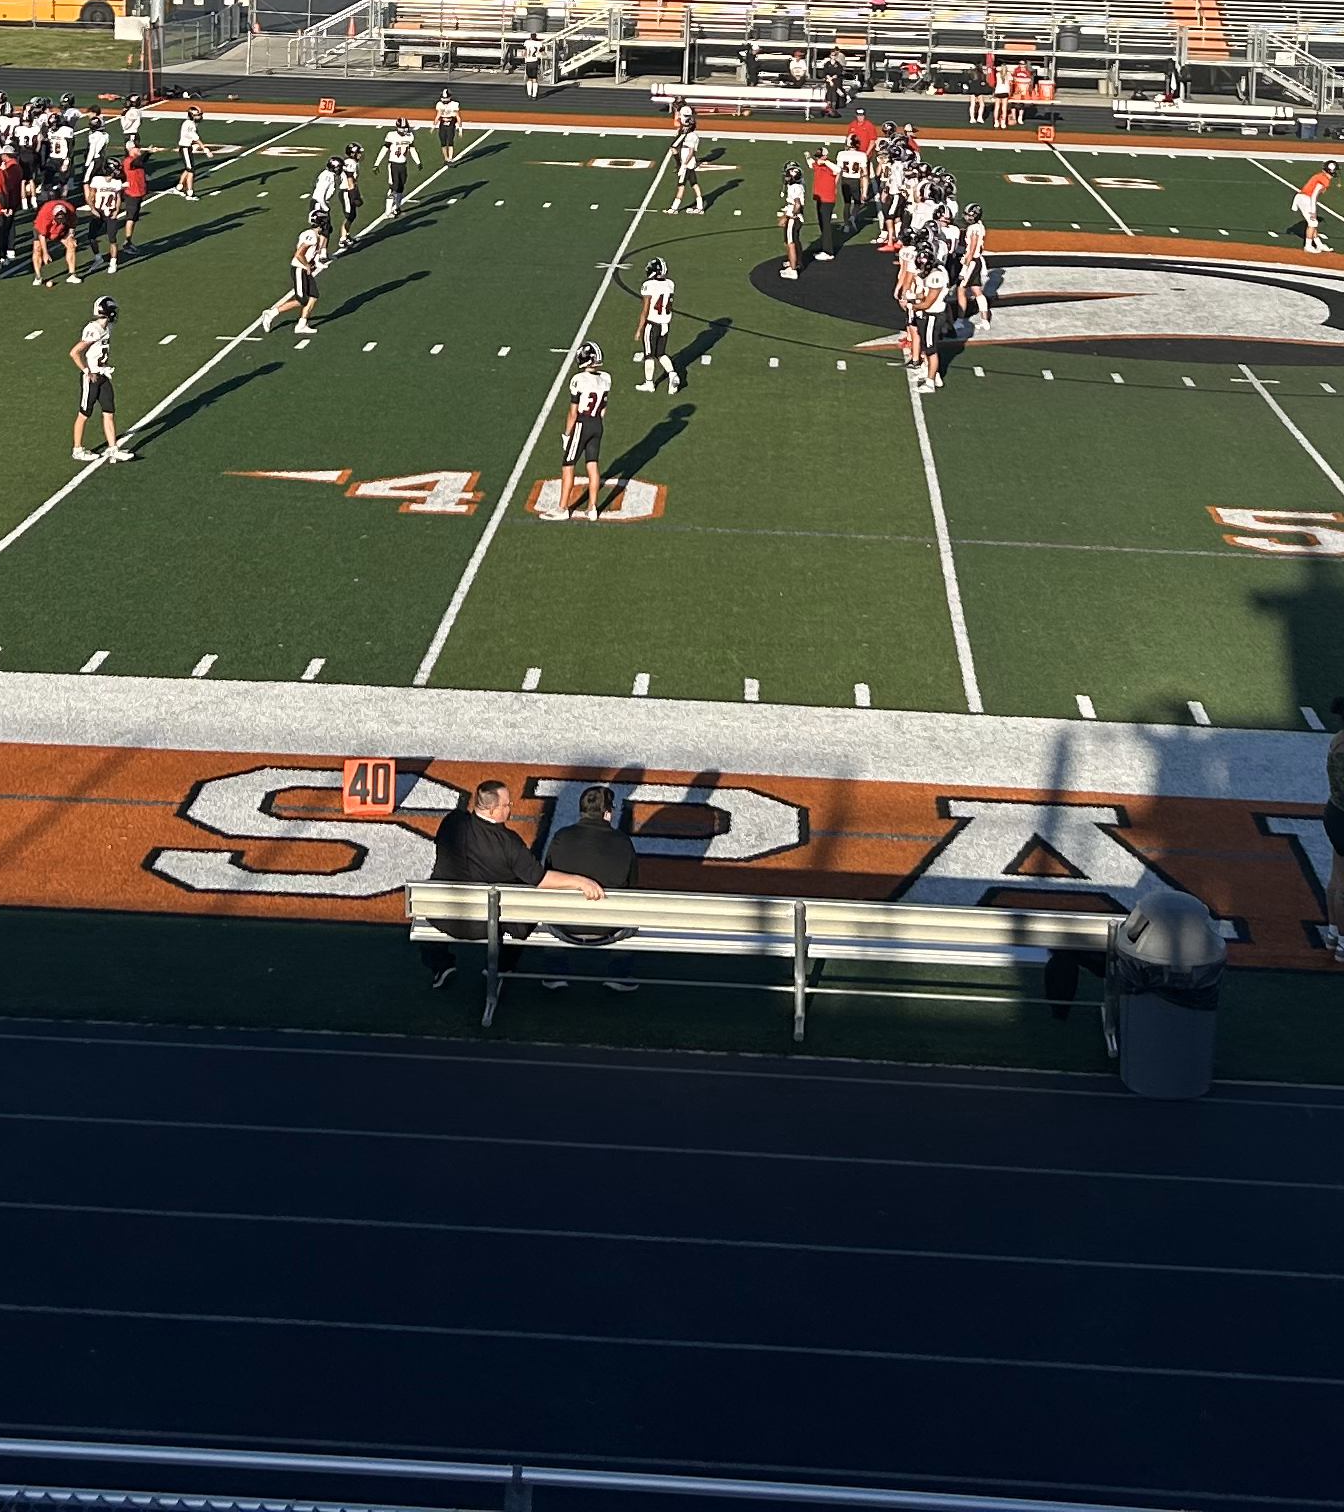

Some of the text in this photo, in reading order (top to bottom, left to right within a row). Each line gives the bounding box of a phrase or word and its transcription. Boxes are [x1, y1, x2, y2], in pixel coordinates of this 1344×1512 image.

[319, 99, 334, 111] 30
[343, 470, 668, 523] 40
[346, 760, 391, 806] 40
